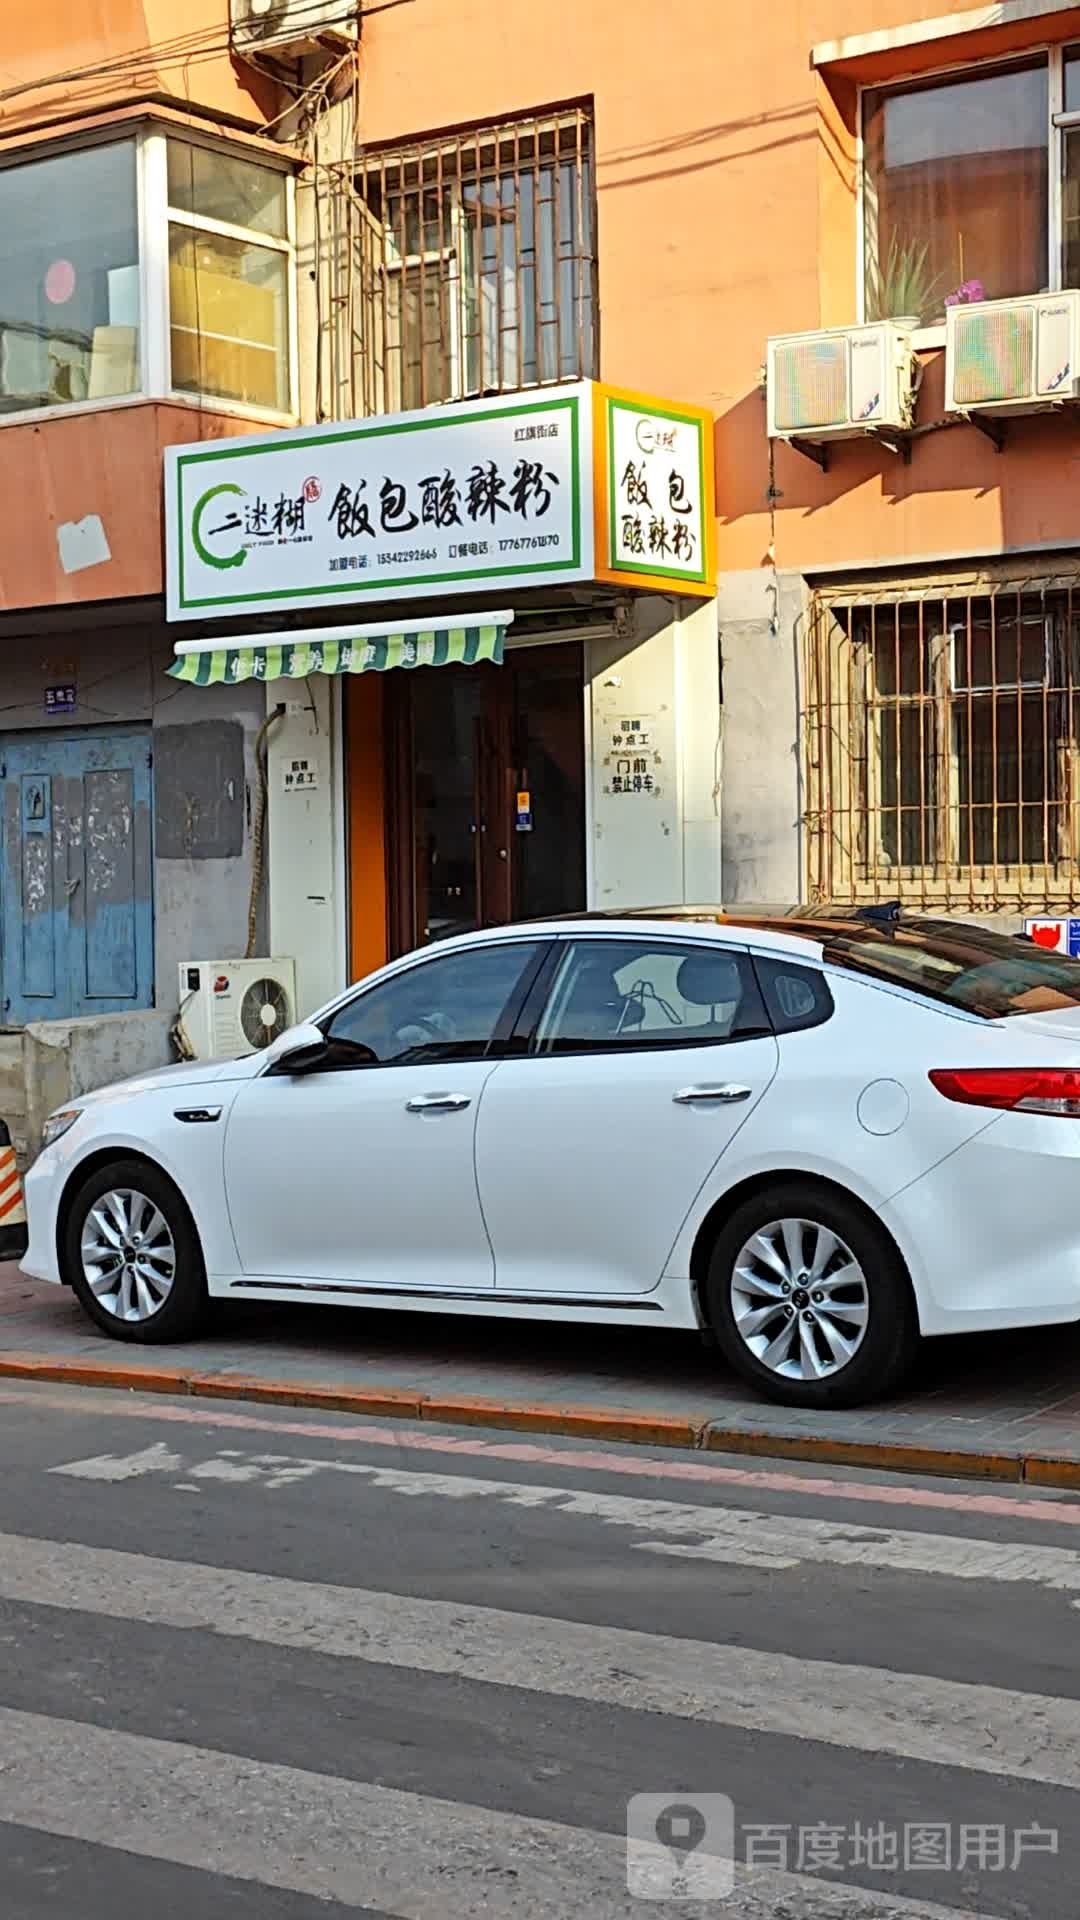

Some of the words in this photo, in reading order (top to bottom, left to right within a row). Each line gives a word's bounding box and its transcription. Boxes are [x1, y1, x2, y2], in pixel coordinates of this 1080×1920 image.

[620, 512, 697, 562] 酸辣粉
[616, 757, 647, 774] 门前
[612, 774, 654, 794] 禁止停车
